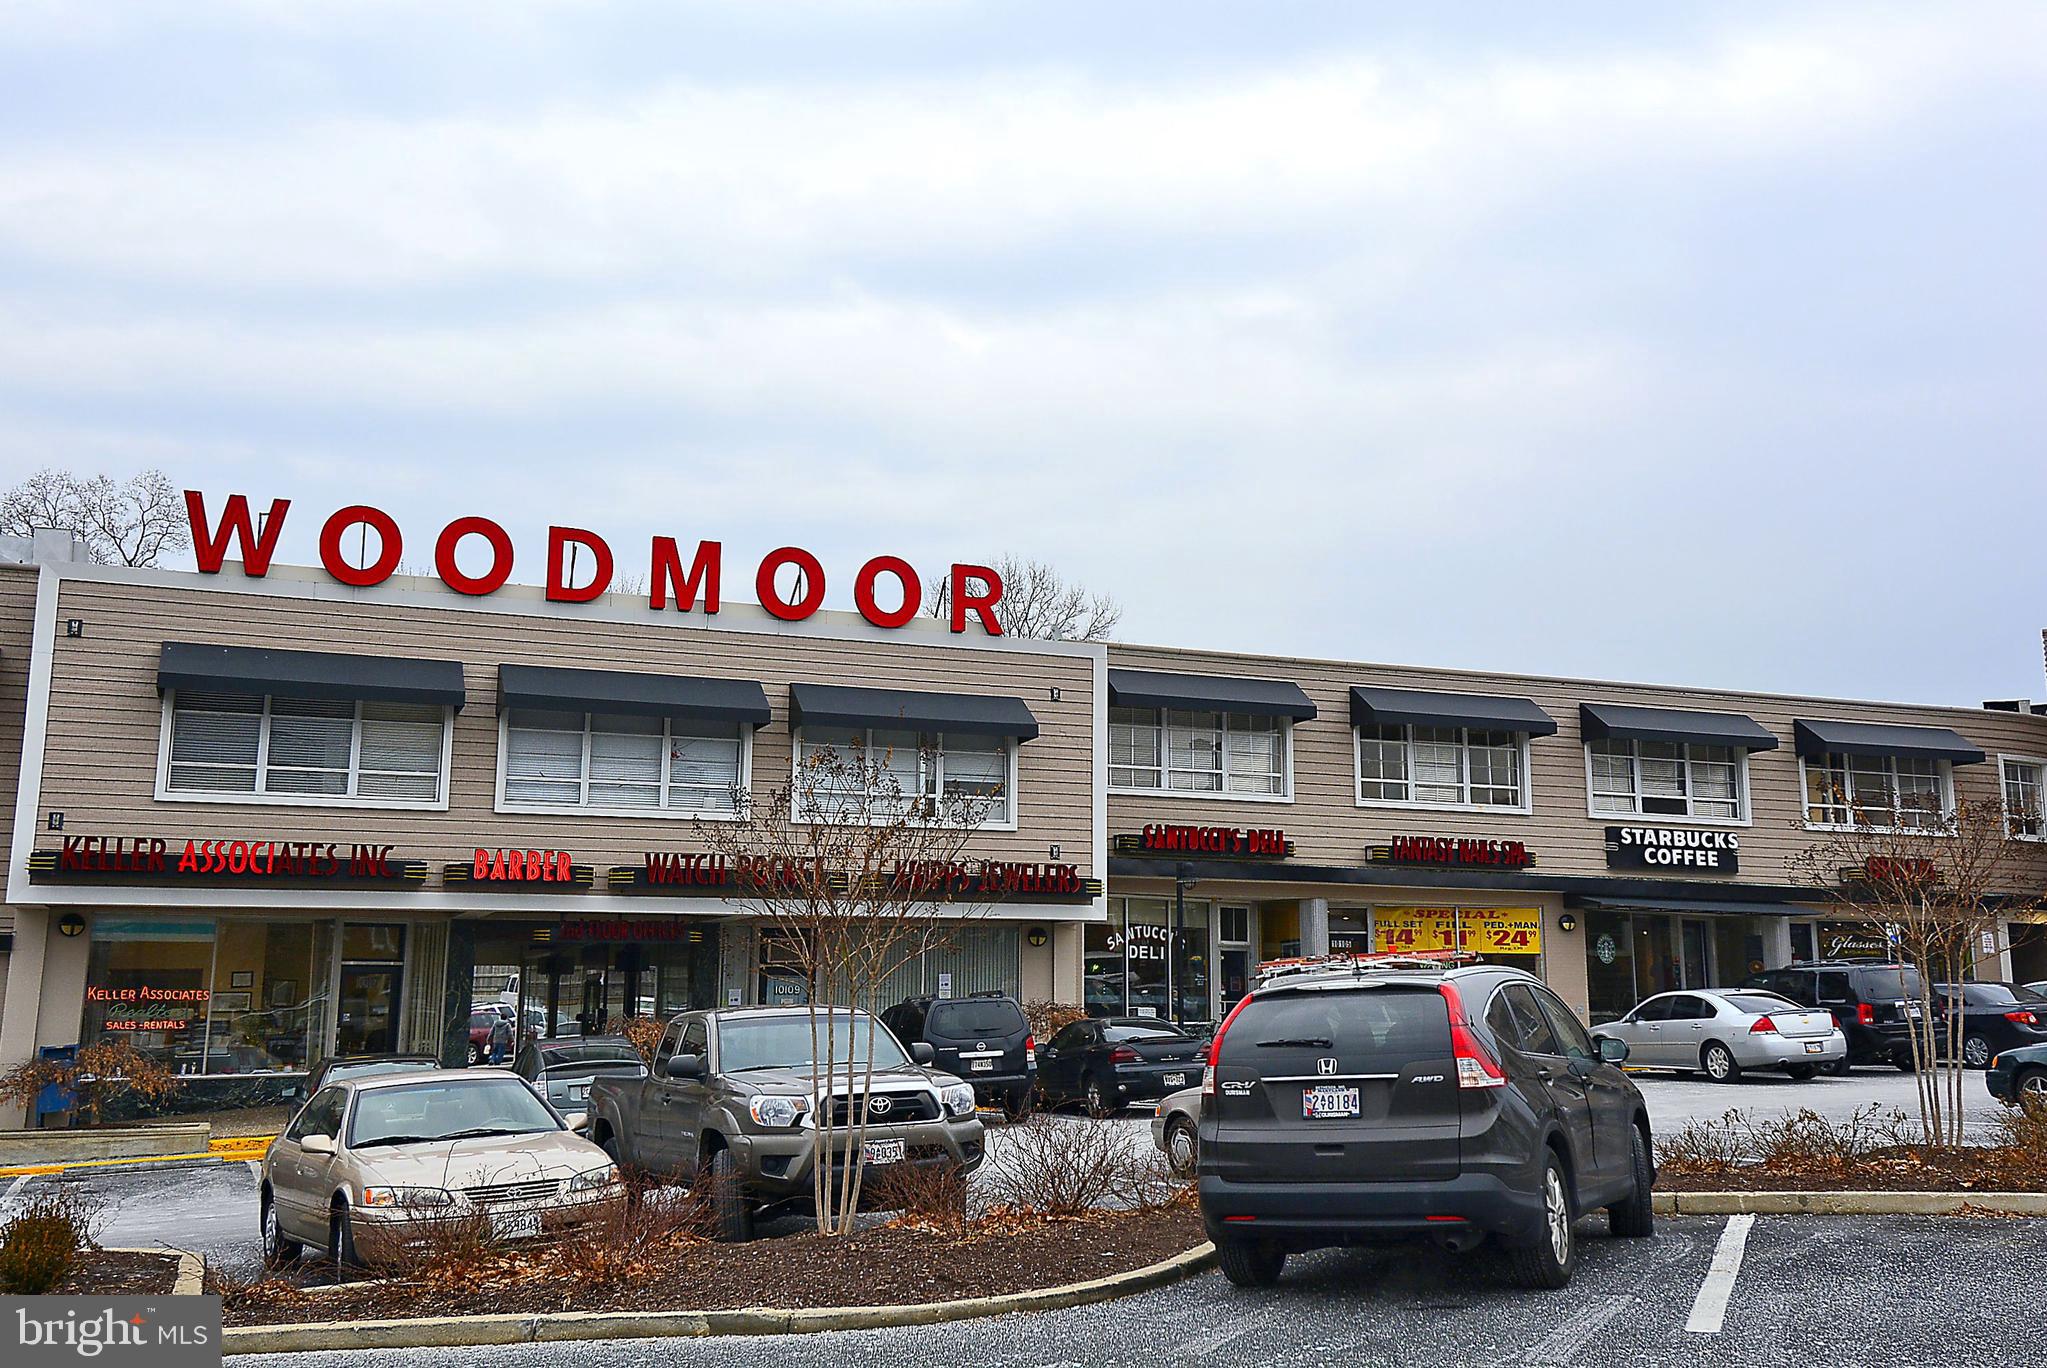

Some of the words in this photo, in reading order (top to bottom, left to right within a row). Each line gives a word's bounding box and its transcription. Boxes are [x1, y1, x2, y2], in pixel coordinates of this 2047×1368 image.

[183, 489, 1003, 636] WOODMOOR
[1143, 824, 1242, 852] SANTUCCI'S
[1247, 829, 1285, 854] DELI
[1620, 827, 1739, 849] STARBUCKS
[60, 835, 167, 873] KELLER
[177, 839, 338, 877] ASSOCIATES
[1391, 835, 1454, 862] FANTASY
[1457, 838, 1499, 865] NAILS
[1500, 840, 1528, 865] SPA
[1644, 847, 1719, 867] COFFEE
[473, 847, 573, 882] BARBER
[644, 852, 727, 885] WATCH
[977, 860, 1082, 893] JEWELERS
[1375, 920, 1400, 928] FULL
[1403, 920, 1423, 928] SET
[1413, 909, 1500, 919] SPECIAL
[1129, 944, 1166, 960] DELI
[87, 985, 136, 1001] KELLER
[140, 985, 210, 1001] ASSOCIATES
[775, 984, 801, 995] 10109
[106, 1021, 136, 1030] SALES
[1411, 1075, 1445, 1083] AWD
